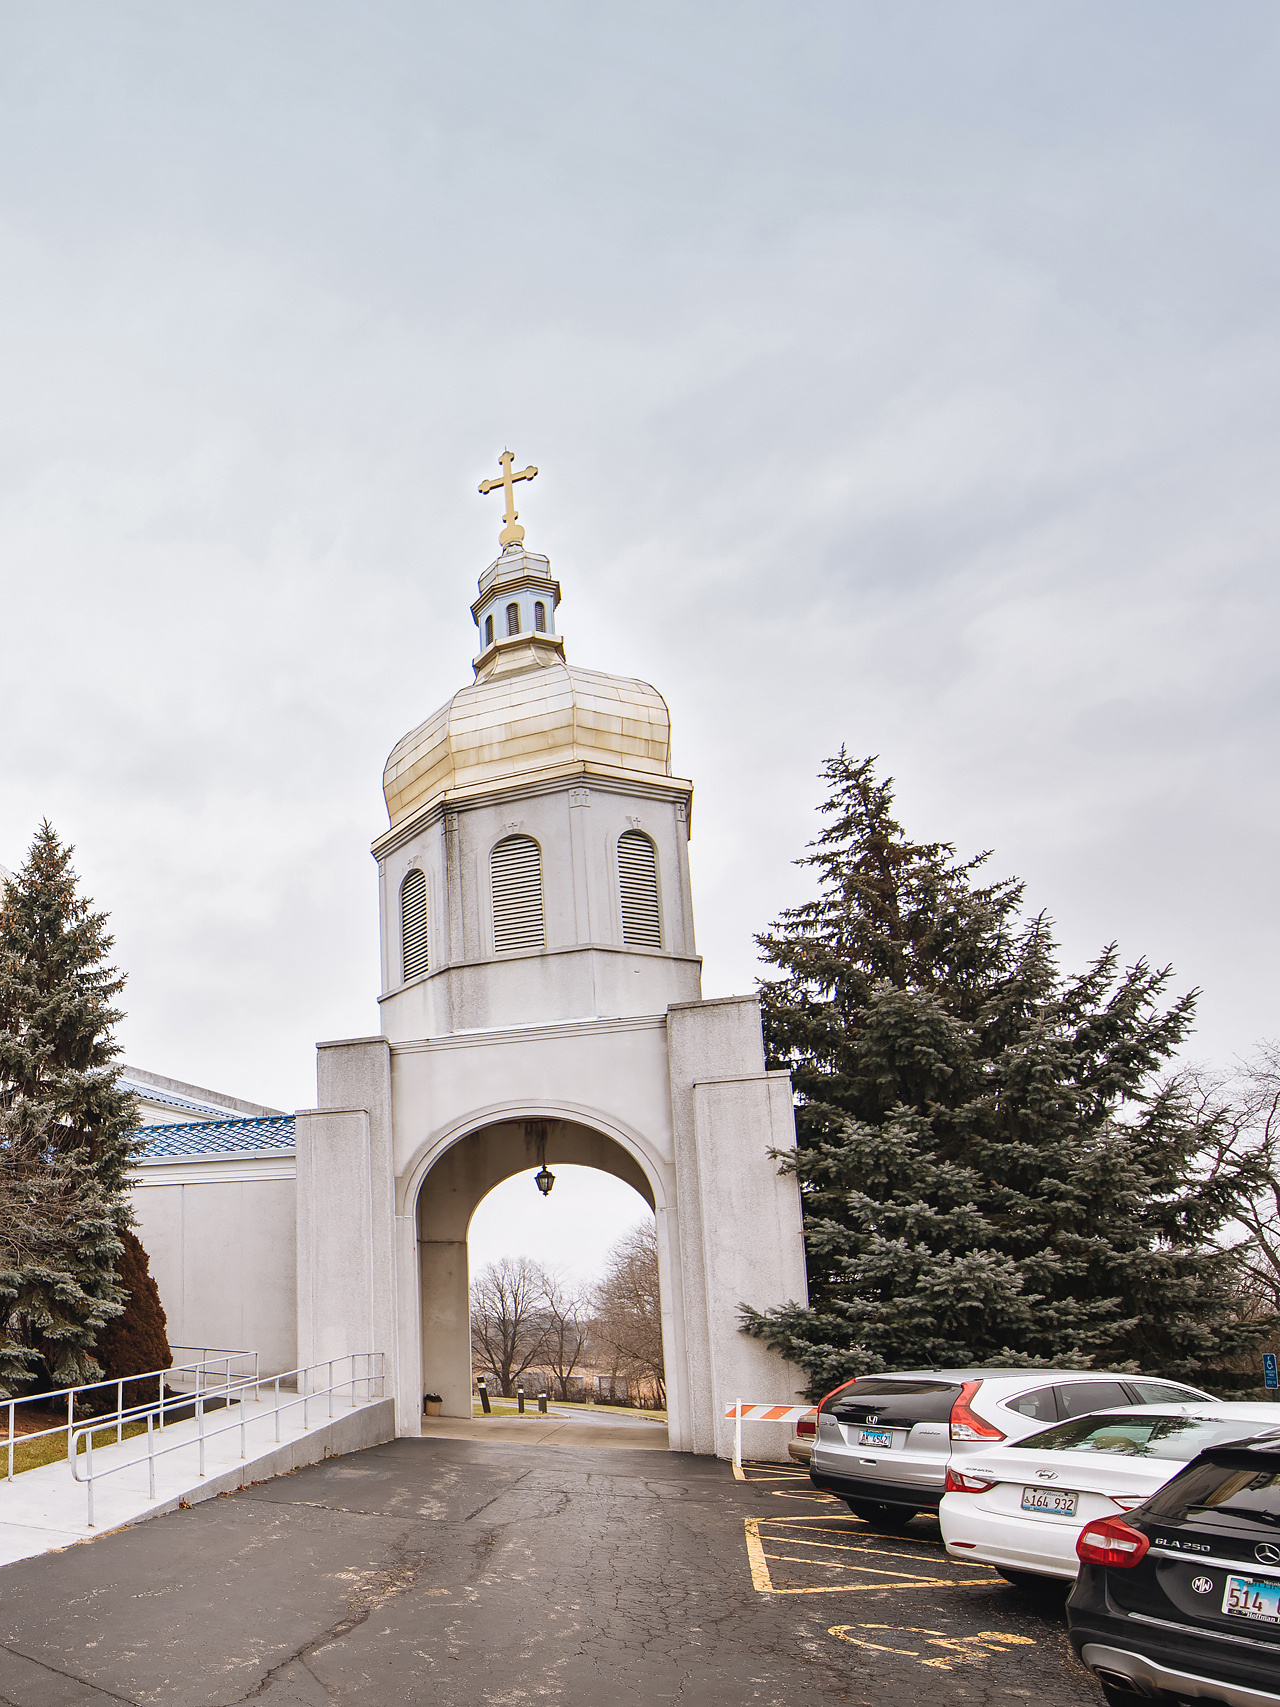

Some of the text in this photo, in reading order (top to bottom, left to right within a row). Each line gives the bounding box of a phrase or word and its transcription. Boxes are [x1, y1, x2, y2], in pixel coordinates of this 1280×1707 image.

[1030, 1494, 1074, 1511] 164 932
[1154, 1537, 1212, 1552] GLA 250
[1228, 1588, 1263, 1611] 514
[1246, 1612, 1276, 1623] Hoffman
